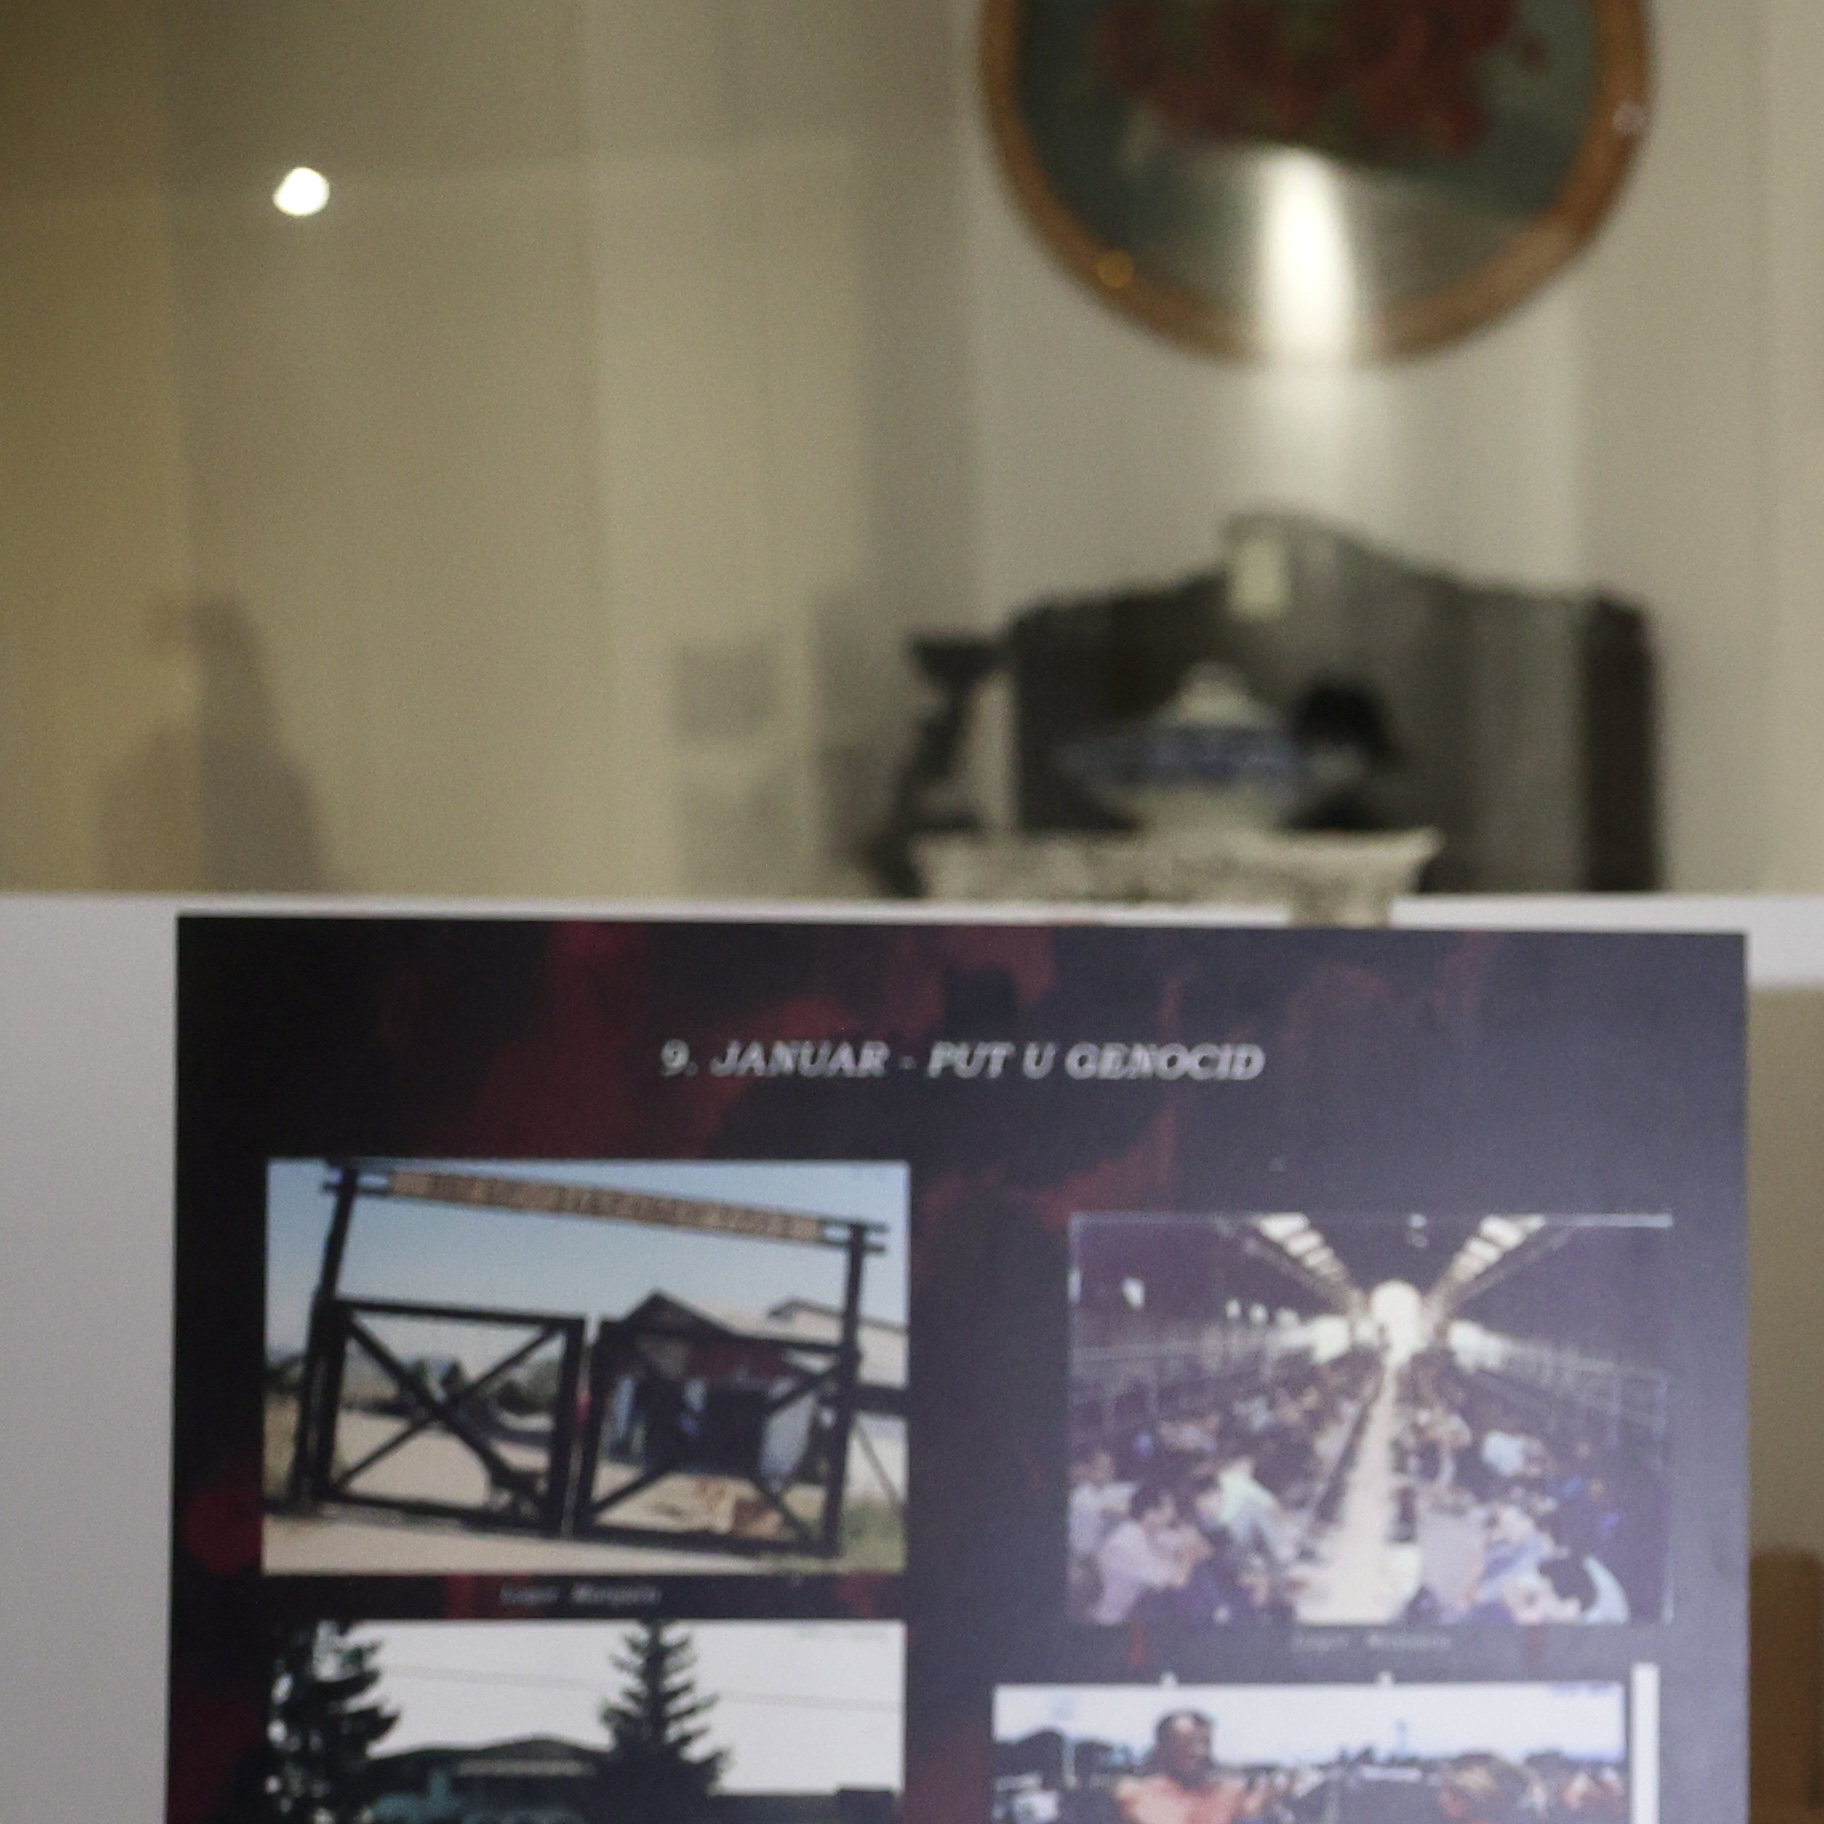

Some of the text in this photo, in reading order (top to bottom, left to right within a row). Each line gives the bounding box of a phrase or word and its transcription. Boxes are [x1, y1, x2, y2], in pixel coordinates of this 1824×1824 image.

[660, 1038, 698, 1078] 9.
[710, 1039, 891, 1079] JANUAR
[926, 1040, 1015, 1080] PUT
[1021, 1041, 1057, 1080] U
[1064, 1041, 1266, 1081] GENOCID
